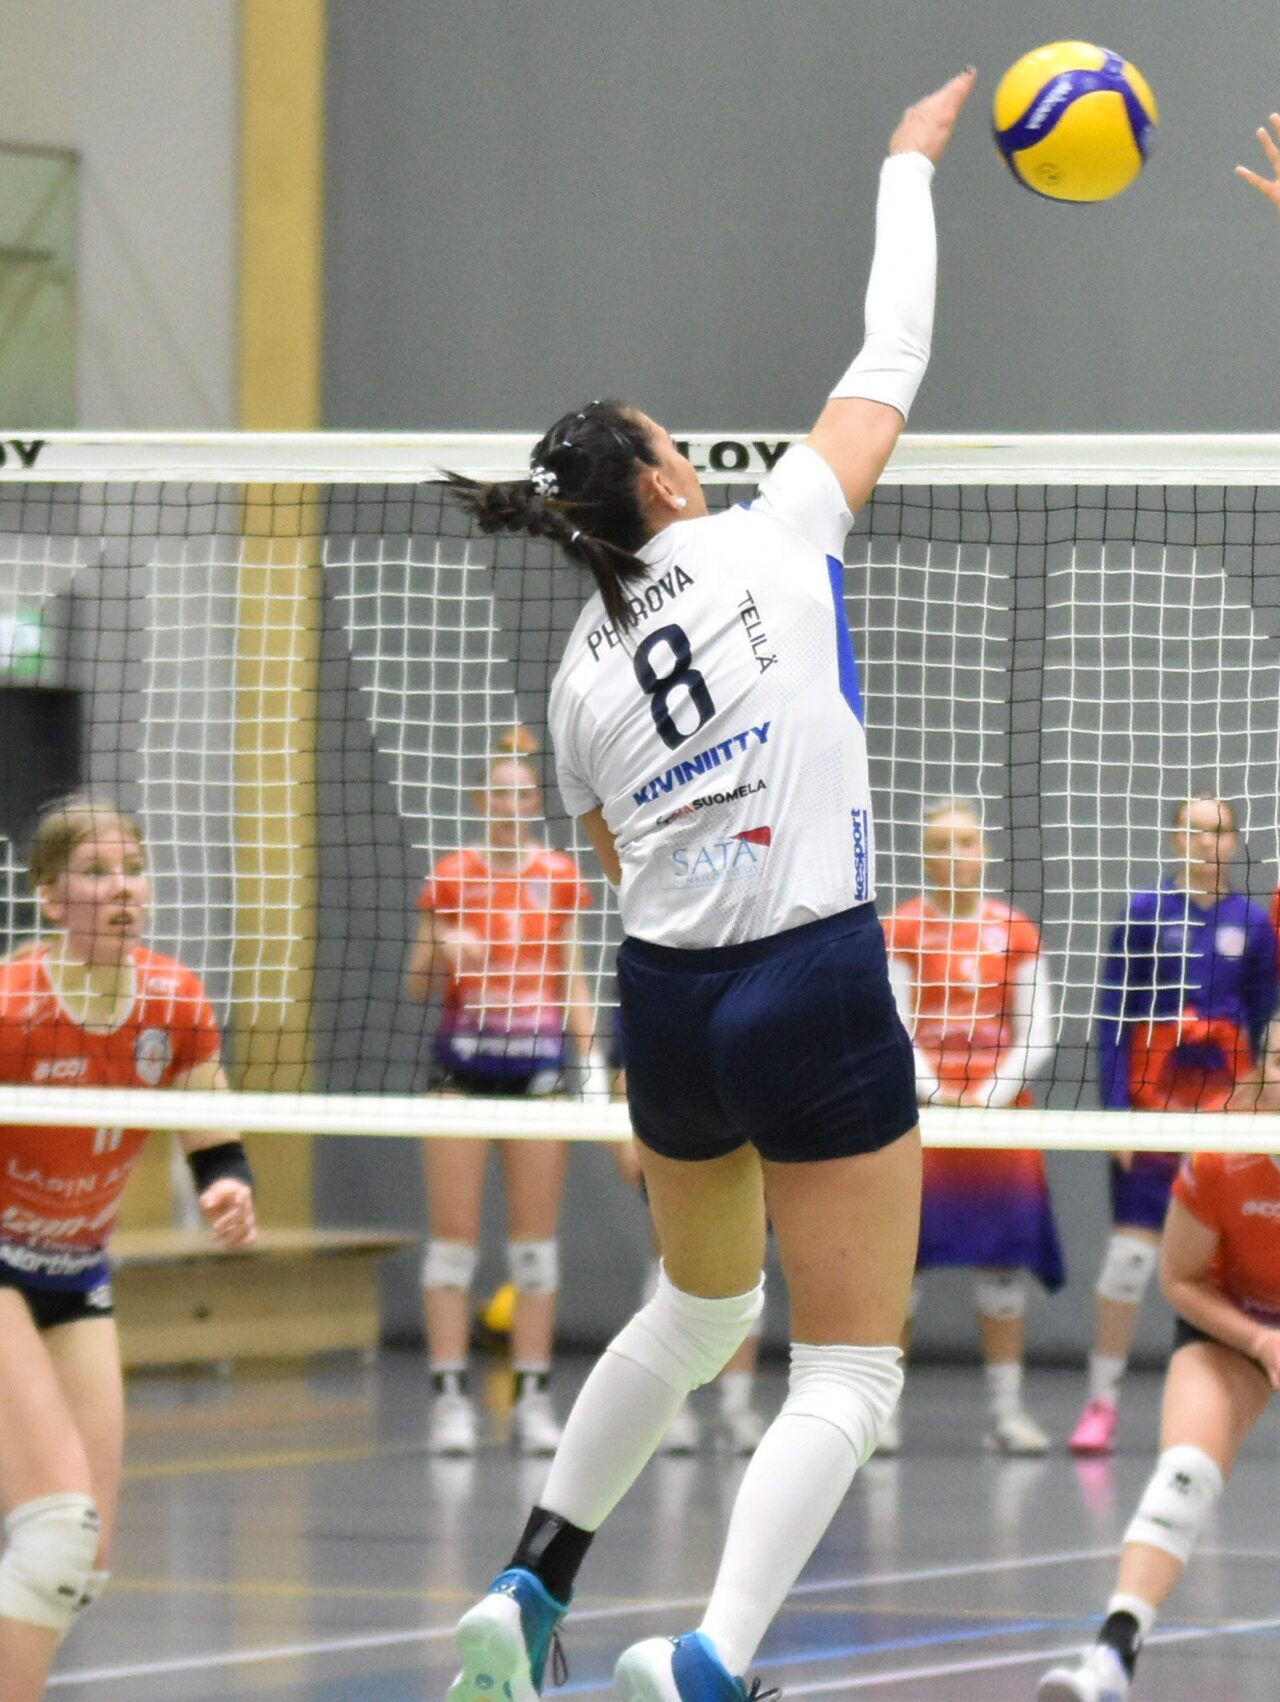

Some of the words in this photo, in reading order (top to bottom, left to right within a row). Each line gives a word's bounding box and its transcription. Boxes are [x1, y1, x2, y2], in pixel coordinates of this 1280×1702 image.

[738, 589, 779, 674] TELILÄ
[633, 623, 716, 751] 8
[633, 721, 771, 807] KIVINIITTY
[672, 837, 757, 877] SATA
